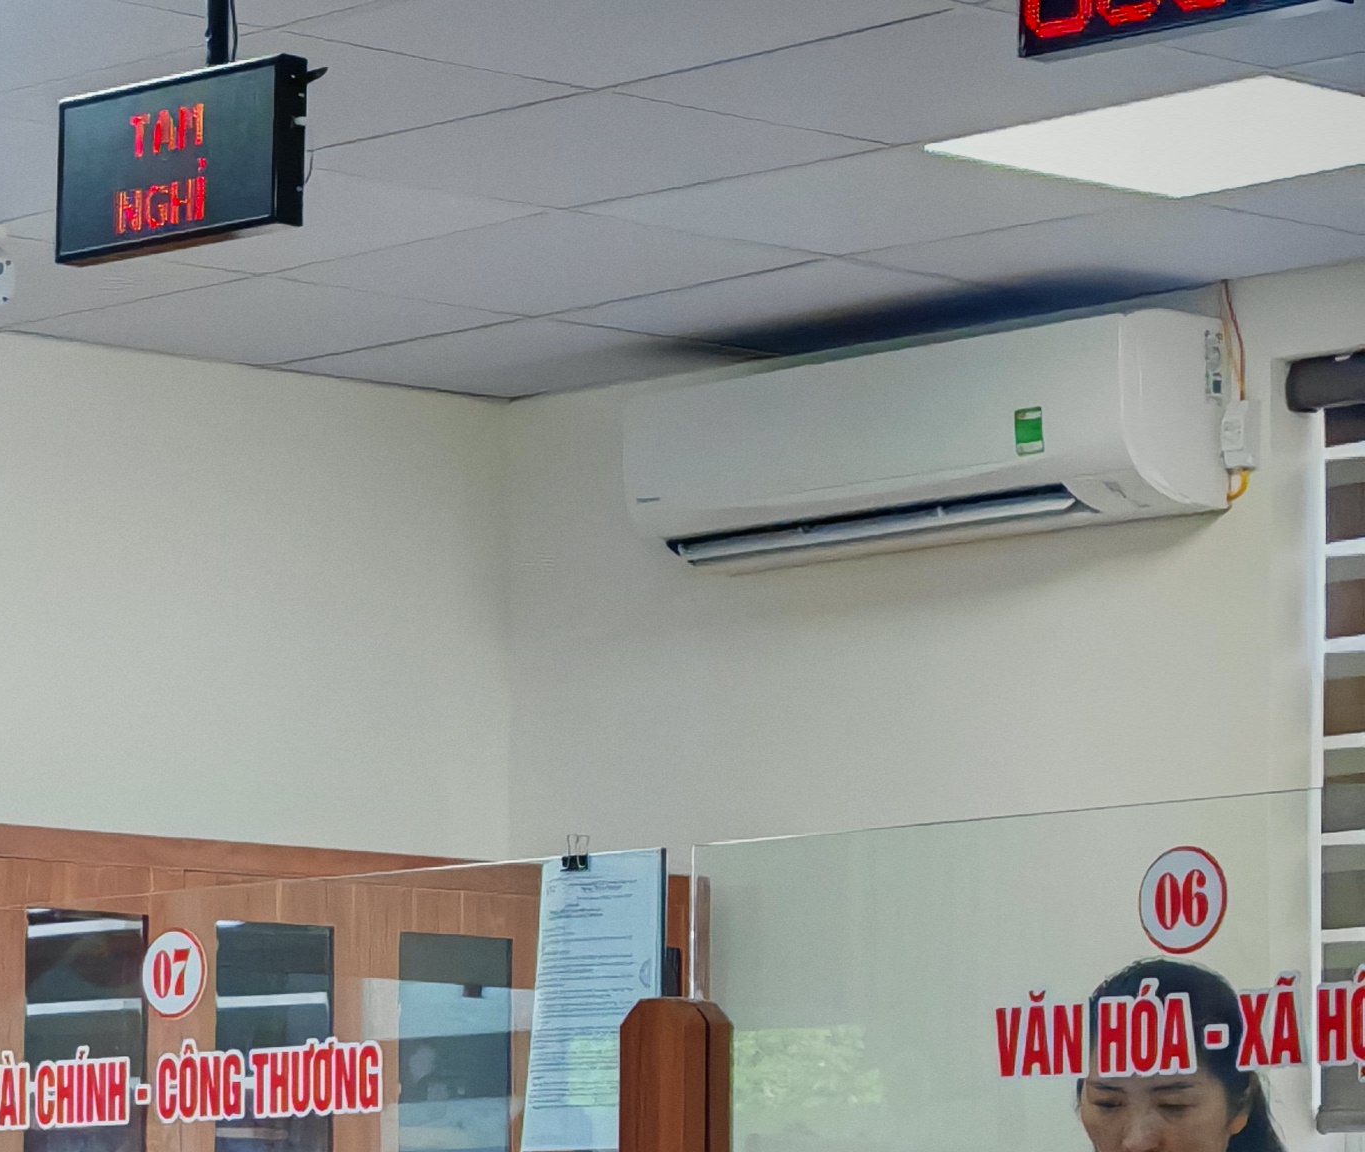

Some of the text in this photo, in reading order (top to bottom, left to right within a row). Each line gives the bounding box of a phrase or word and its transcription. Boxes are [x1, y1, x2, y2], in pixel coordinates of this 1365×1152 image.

[1155, 869, 1209, 931] 06
[153, 946, 191, 999] 07
[995, 989, 1084, 1077] VĂN
[1099, 984, 1191, 1073] HÓA
[1238, 975, 1302, 1067] XÃ
[35, 1049, 127, 1124] CHÍNH
[156, 1043, 242, 1118] CÔNG
[253, 1041, 379, 1114] THƯƠNG
